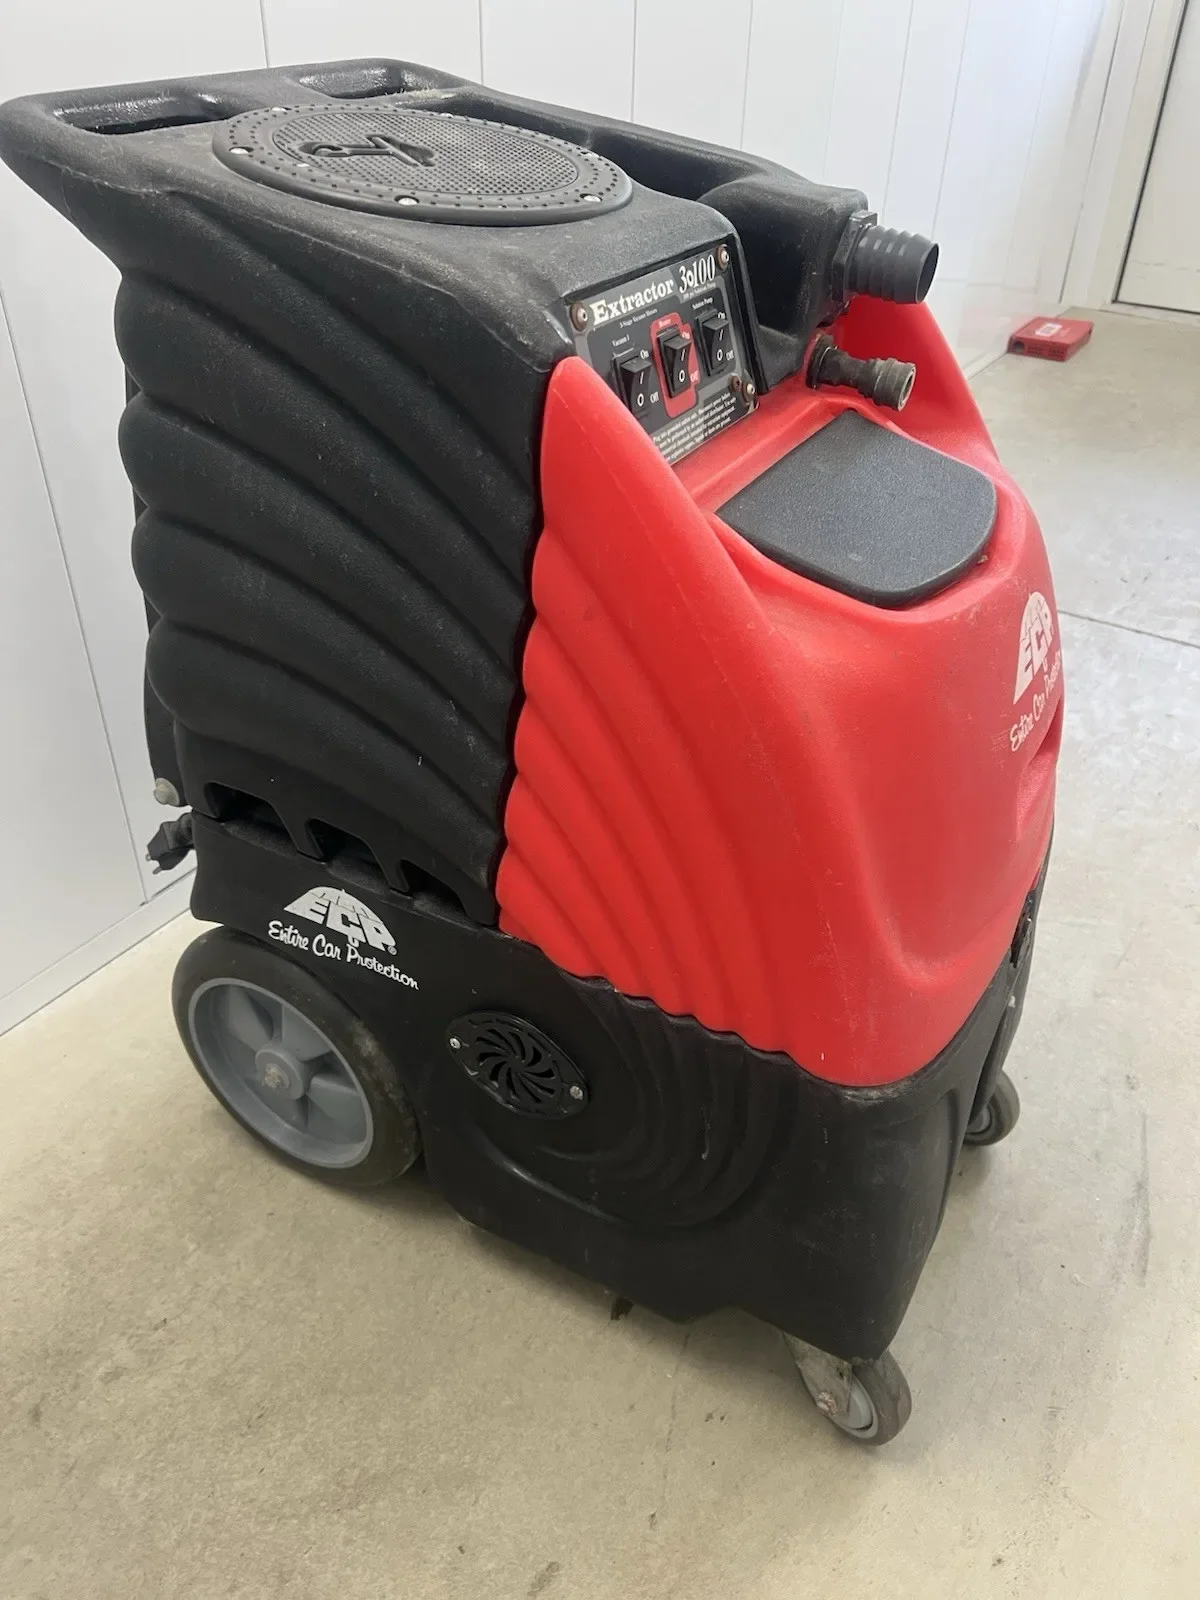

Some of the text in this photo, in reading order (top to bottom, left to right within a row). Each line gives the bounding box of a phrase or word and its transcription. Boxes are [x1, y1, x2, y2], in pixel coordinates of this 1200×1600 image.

[589, 277, 674, 326] Extractor
[640, 349, 650, 360] On
[726, 350, 735, 361] Off
[690, 371, 700, 382] Off
[650, 391, 659, 404] Off
[1010, 714, 1034, 752] Entire
[1033, 693, 1046, 722] Car
[268, 920, 420, 990] Entire Car Protection
